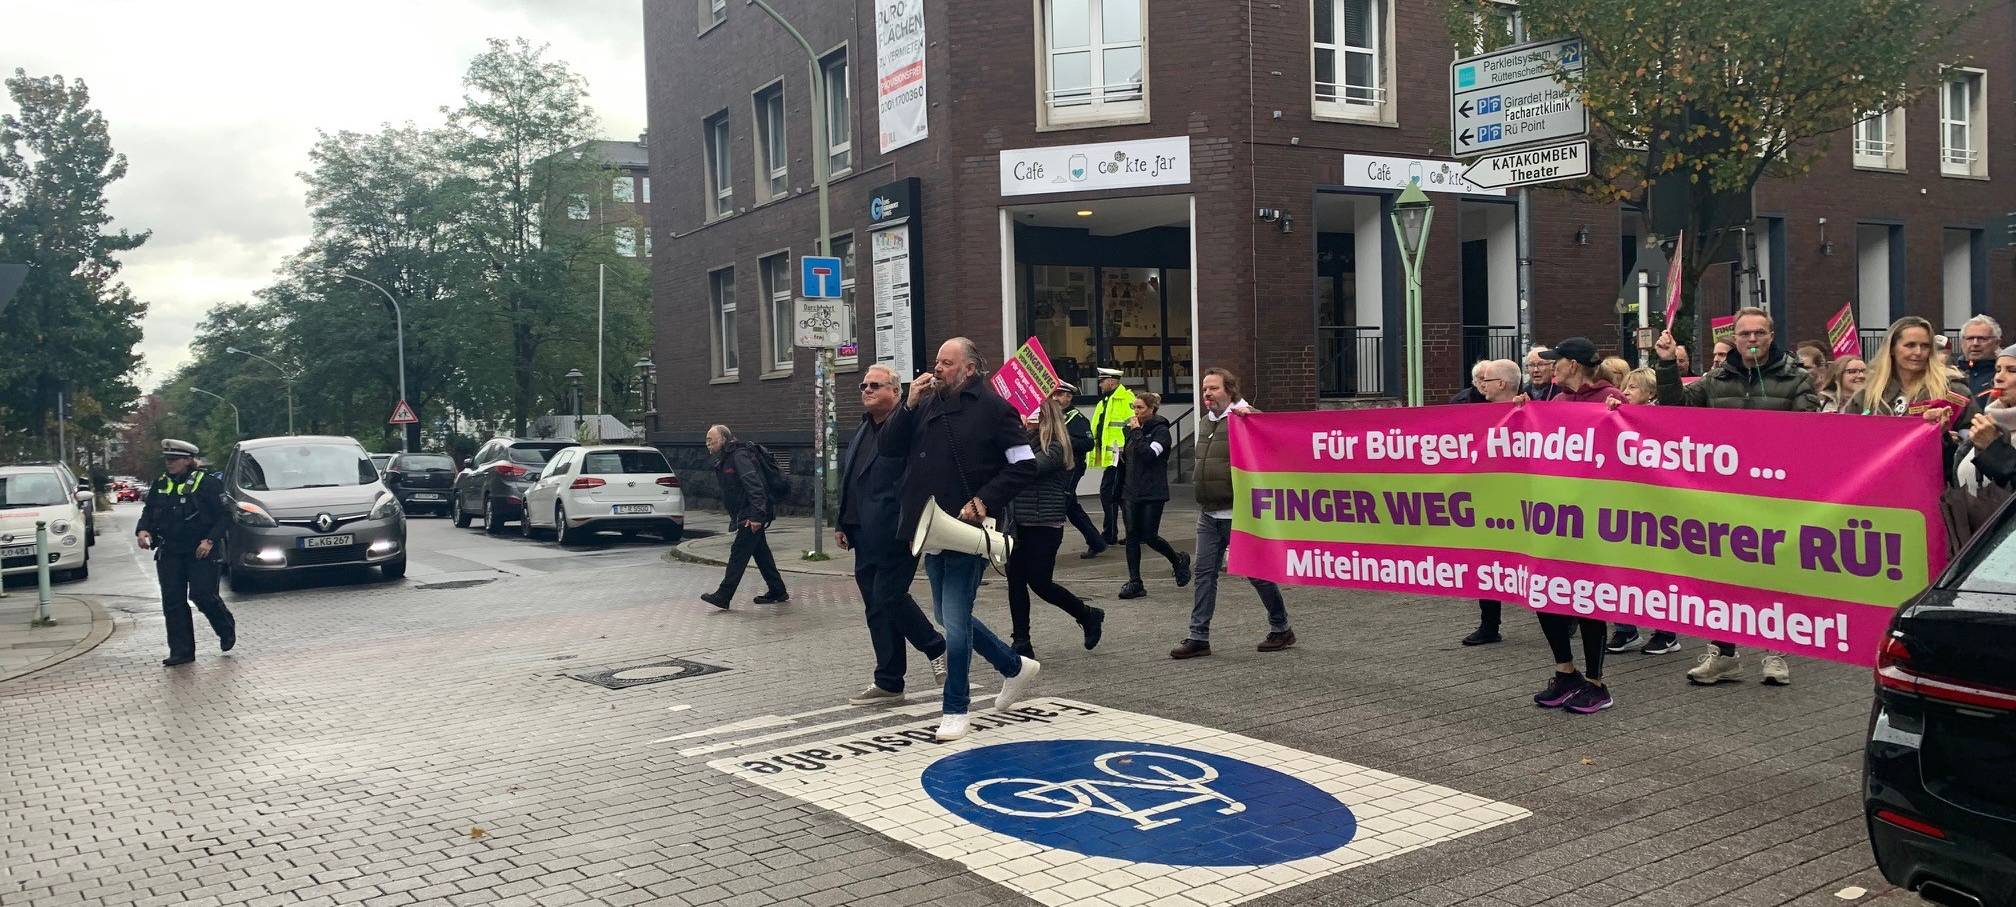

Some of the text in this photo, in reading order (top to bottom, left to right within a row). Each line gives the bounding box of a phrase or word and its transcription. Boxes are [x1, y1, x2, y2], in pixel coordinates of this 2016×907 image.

[1504, 91, 1542, 109] Girardet
[1504, 99, 1570, 122] Facharztklinik
[1504, 123, 1519, 136] Rü
[1521, 119, 1546, 133] Point
[1013, 160, 1045, 181] Café
[1151, 154, 1176, 177] jar
[1367, 161, 1392, 181] Café
[1492, 146, 1578, 171] KATAKOMBEN
[1510, 165, 1560, 182] Theater
[1023, 346, 1056, 389] FINGER WEG
[1312, 429, 1358, 460] Für
[1366, 428, 1478, 465] Bürger,
[1486, 426, 1605, 468] Handel,
[1616, 431, 1739, 476] Gastro
[308, 535, 350, 547] E KG 267
[1251, 488, 1380, 524] FINGER
[1383, 491, 1475, 528] WEG
[1520, 500, 1584, 539] von
[1597, 507, 1787, 565] unserer
[1800, 518, 1904, 581] RÜ!
[1286, 548, 1850, 652] Miteinander statt gegeneinander!
[741, 702, 1099, 774] Fahrrdstraße
